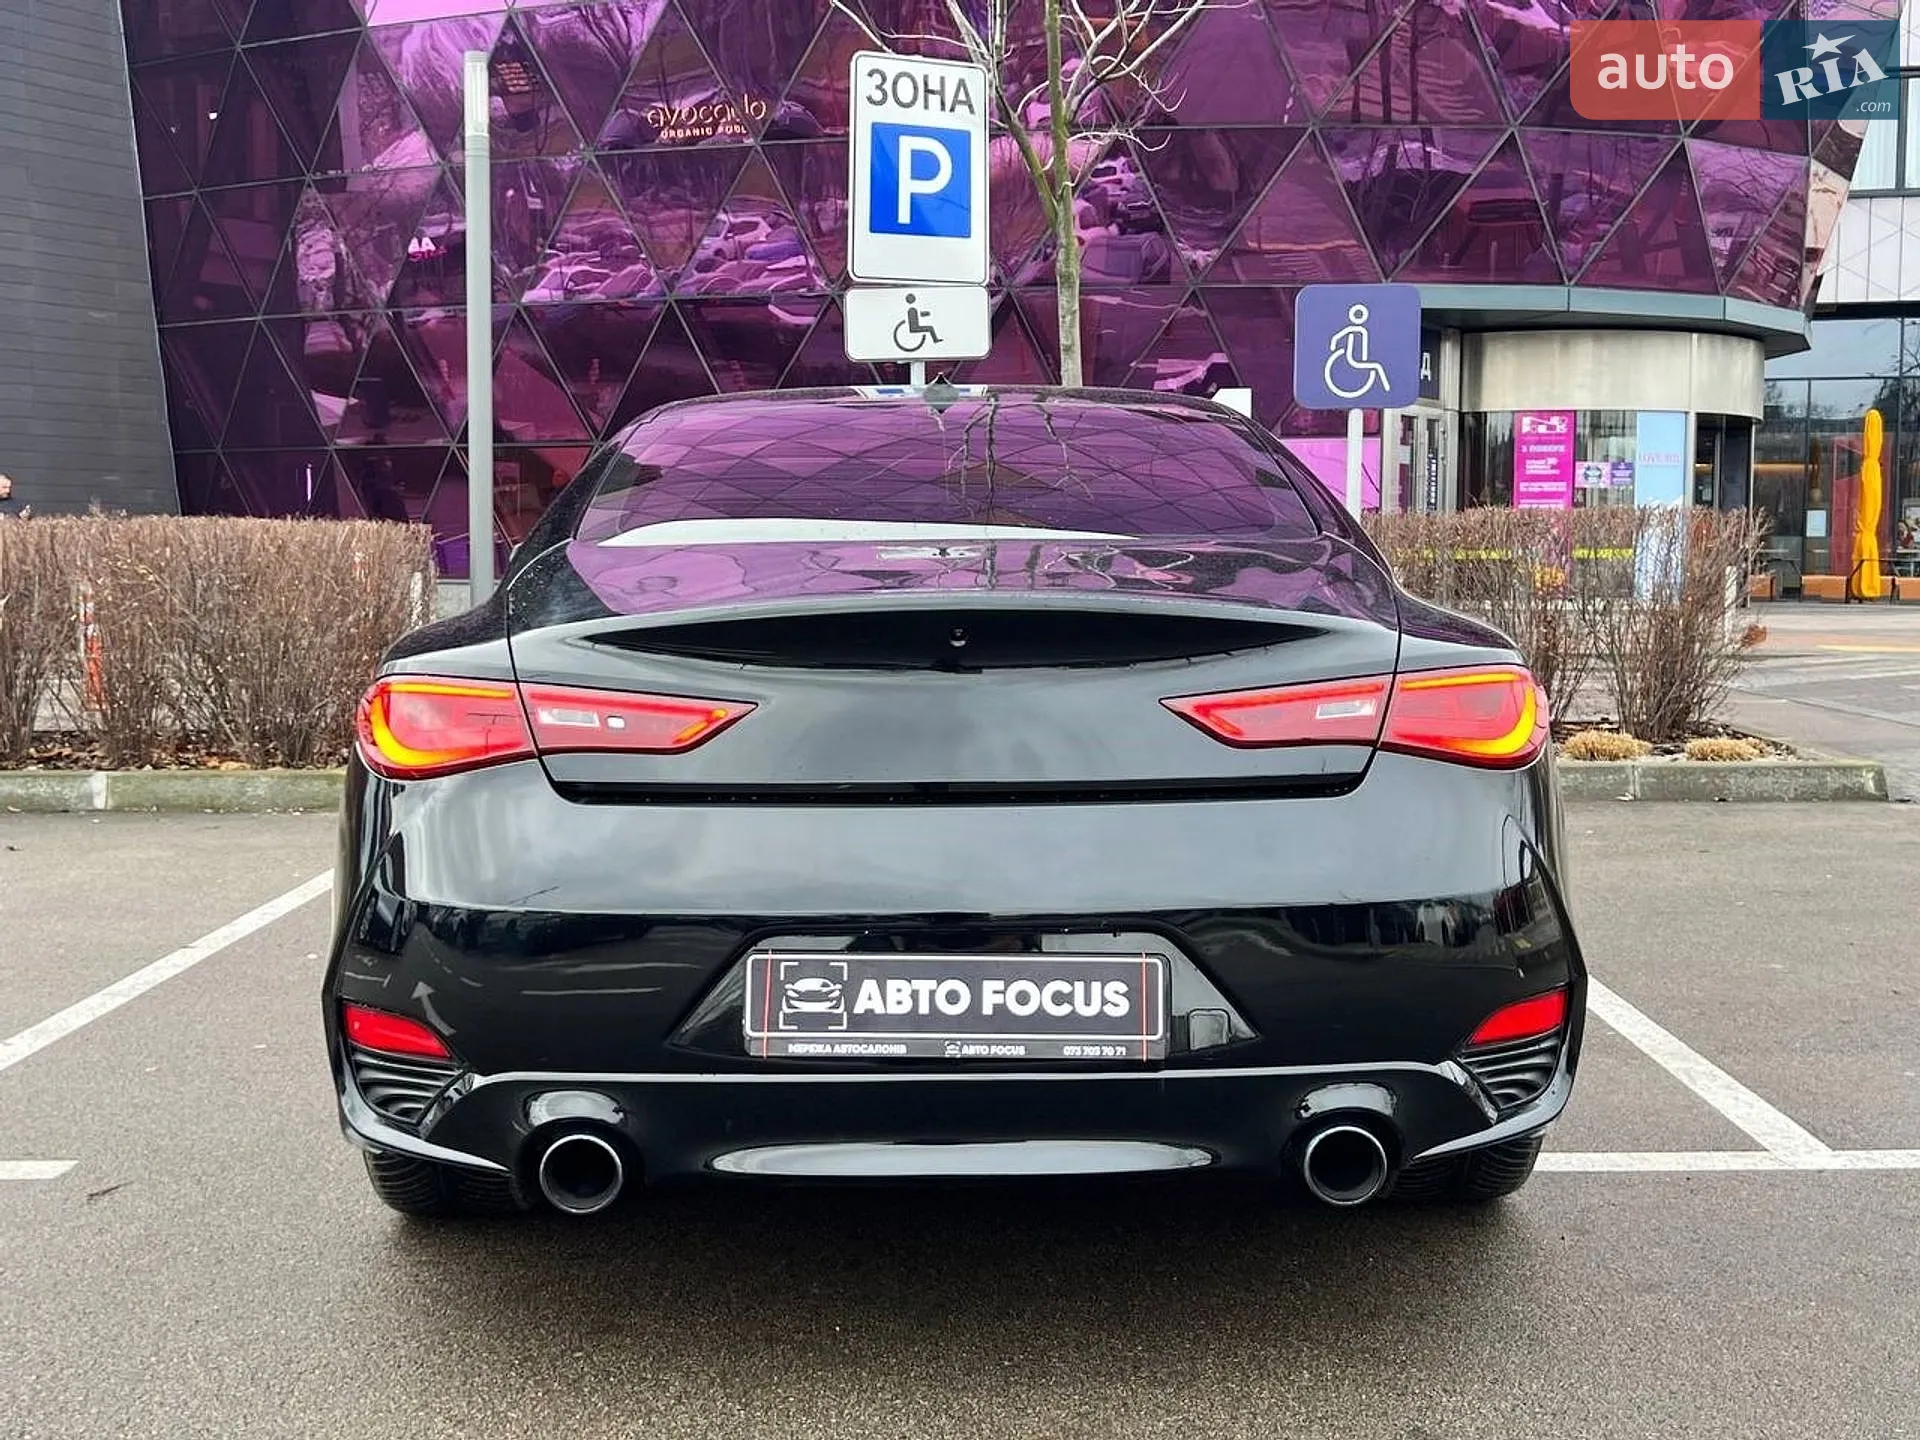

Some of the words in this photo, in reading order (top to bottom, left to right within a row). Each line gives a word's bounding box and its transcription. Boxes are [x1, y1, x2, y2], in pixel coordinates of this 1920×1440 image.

[866, 68, 975, 115] ЗОНА
[897, 135, 953, 225] P
[853, 979, 972, 1016] АВТО
[982, 980, 1130, 1017] FOCUS
[788, 1043, 832, 1055] МЕРЕЖА
[833, 1043, 907, 1056] АВТОСАЛОНІВ
[962, 1044, 989, 1056] АВТО
[990, 1045, 1026, 1056] FOCUS
